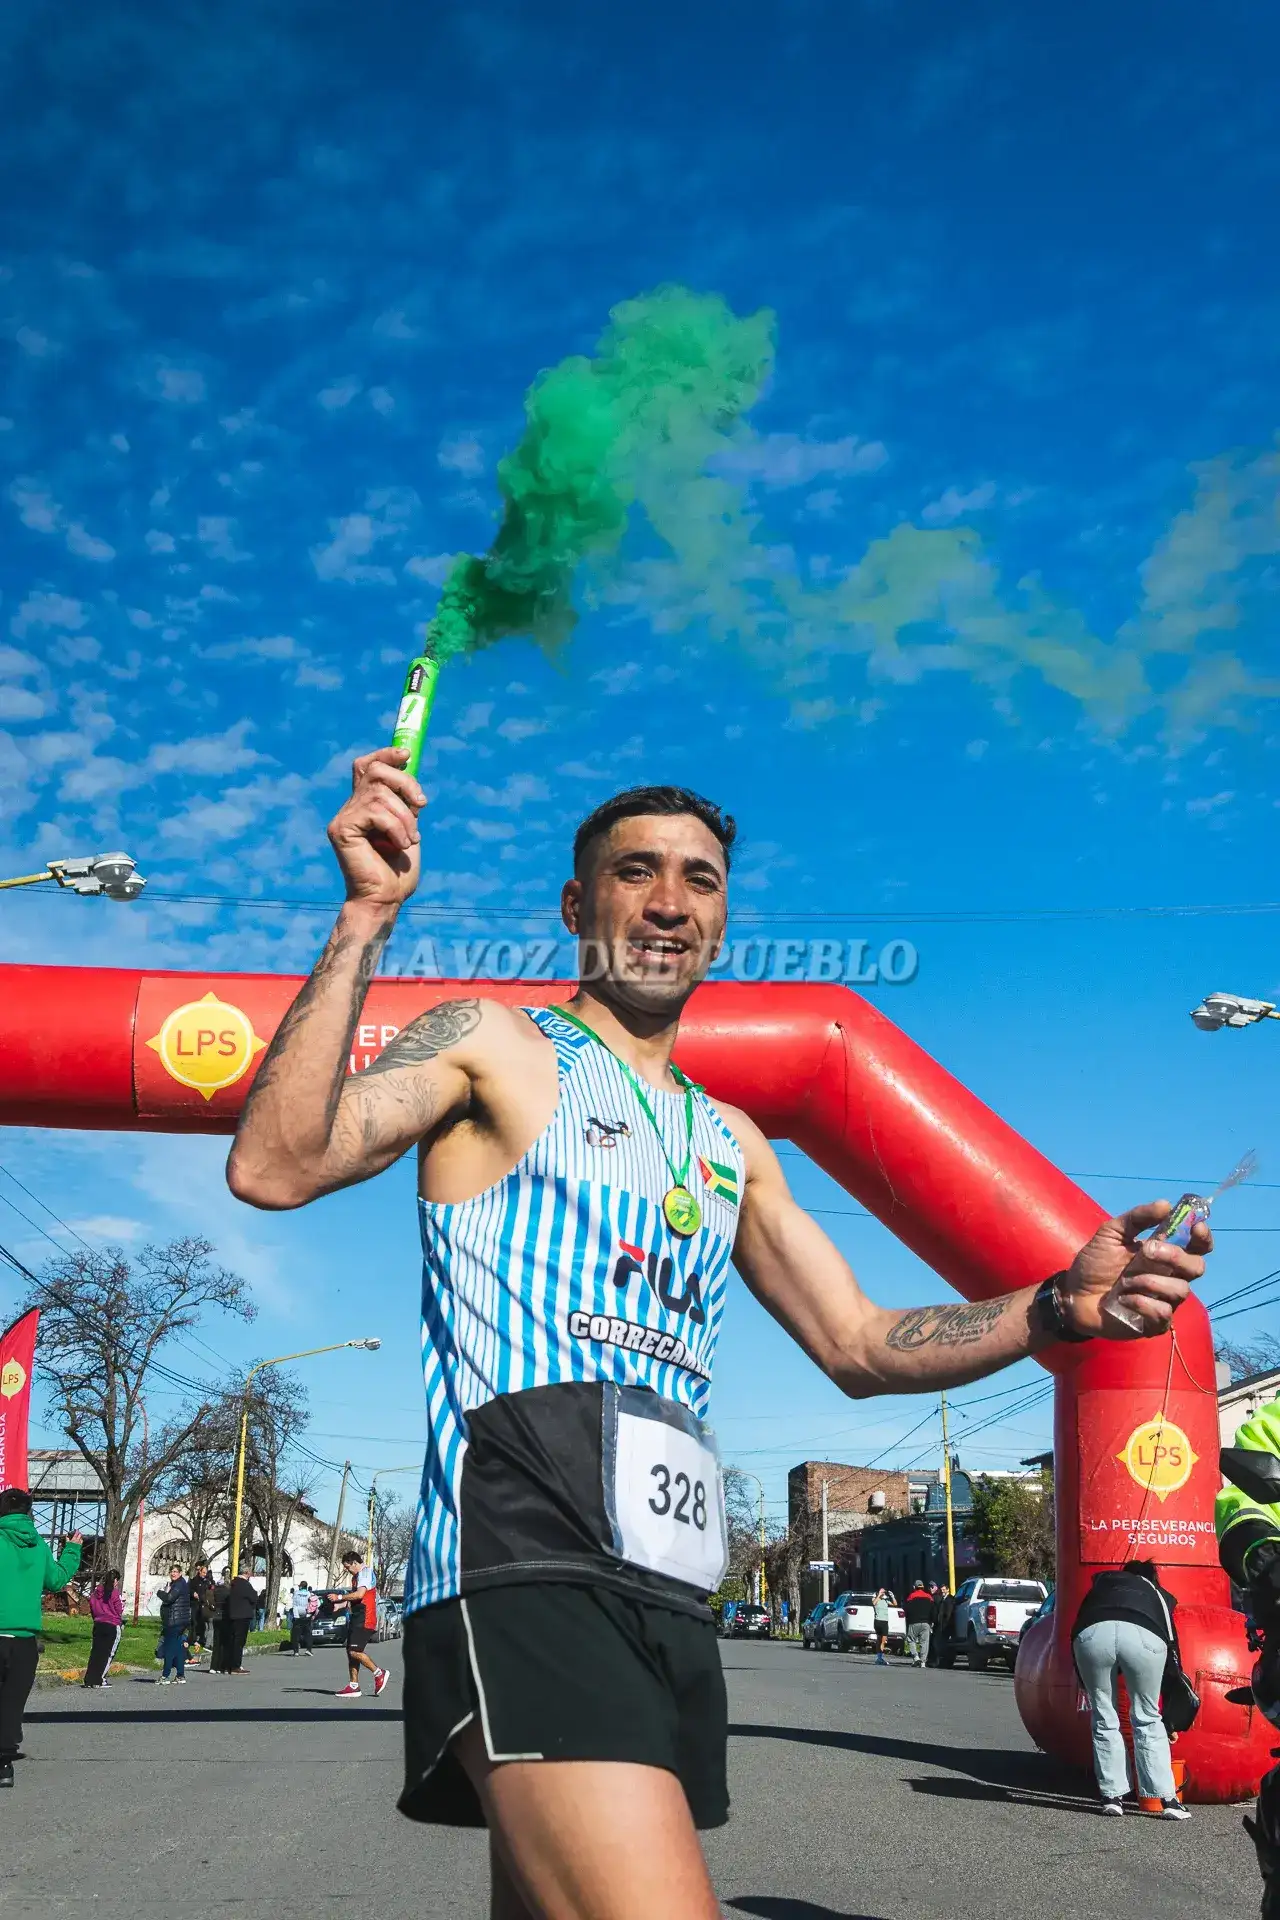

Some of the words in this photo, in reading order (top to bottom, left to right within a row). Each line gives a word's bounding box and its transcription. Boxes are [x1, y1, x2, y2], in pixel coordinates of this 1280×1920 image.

[177, 1030, 236, 1056] LPS
[613, 1239, 705, 1325] FILA
[2, 1373, 19, 1385] LPS
[1138, 1445, 1182, 1466] LPS
[648, 1463, 707, 1531] 328
[1091, 1519, 1108, 1531] LA
[1127, 1533, 1196, 1546] SEGUROS
